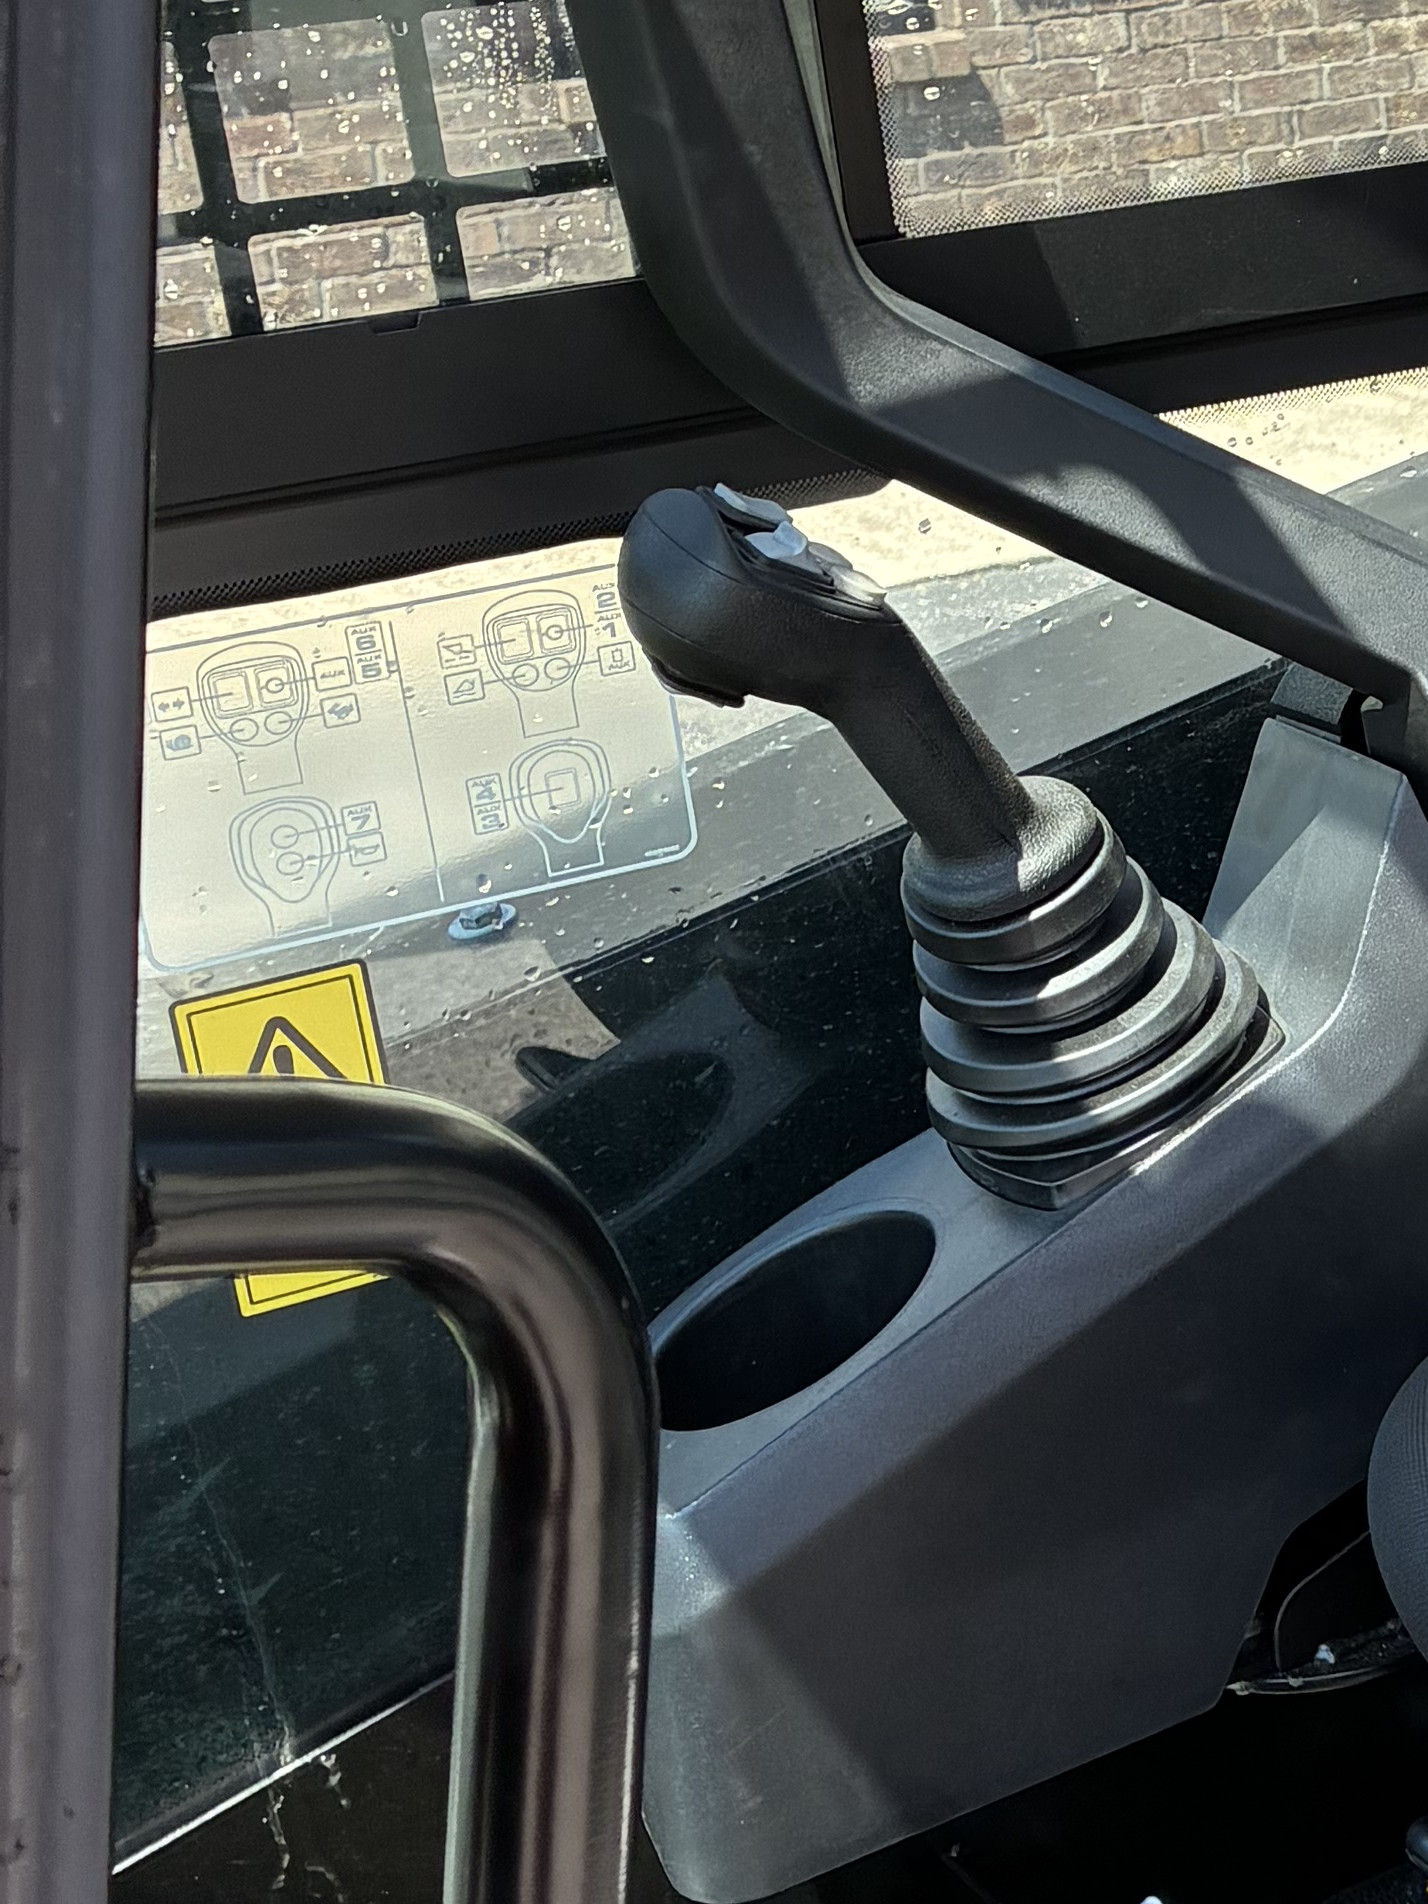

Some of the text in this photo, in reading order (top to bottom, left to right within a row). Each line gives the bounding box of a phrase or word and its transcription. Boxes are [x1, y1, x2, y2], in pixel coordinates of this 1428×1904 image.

[596, 591, 617, 609] 2
[350, 625, 377, 636] AUX
[601, 621, 617, 638] 1
[355, 634, 377, 651] 6
[356, 653, 382, 664] AUX
[320, 669, 346, 679] AUX
[361, 661, 382, 679] 5
[475, 786, 497, 802] 4
[350, 813, 371, 831] 7
[480, 812, 501, 830] 3
